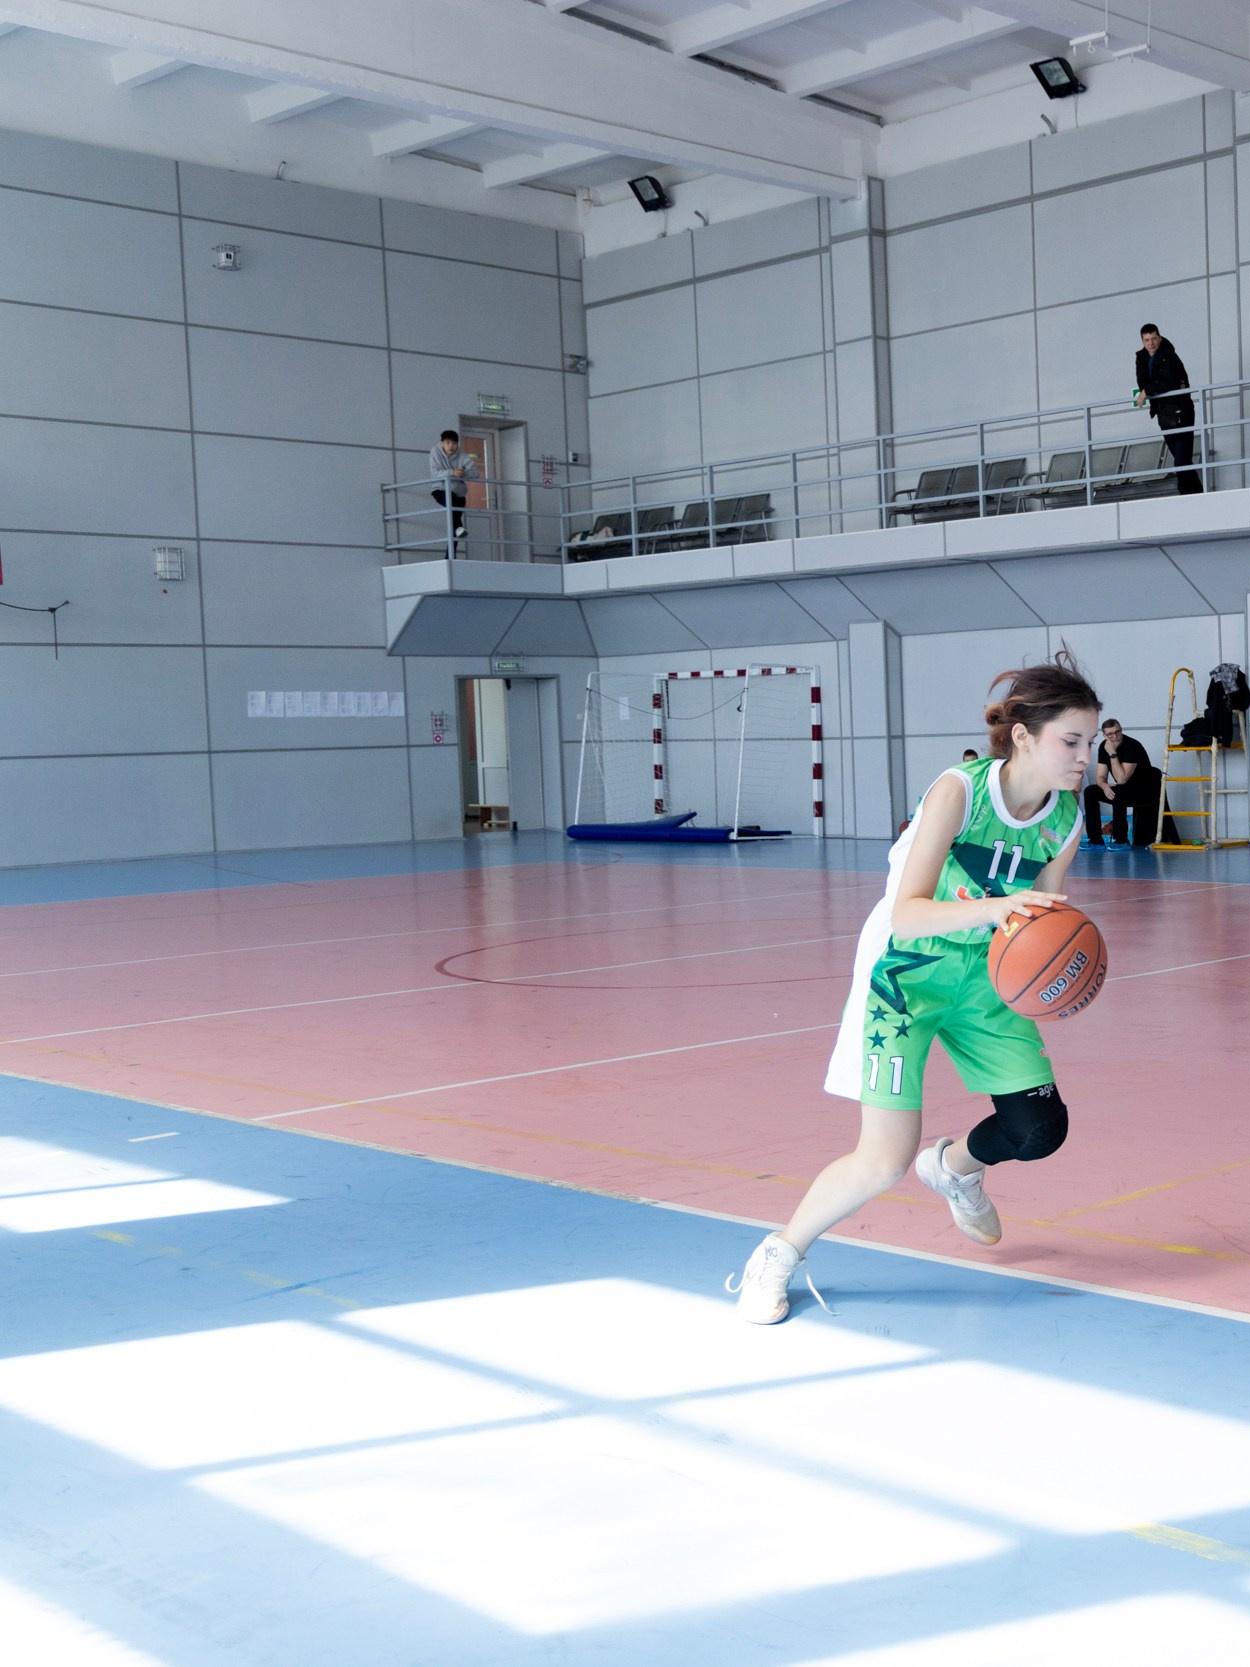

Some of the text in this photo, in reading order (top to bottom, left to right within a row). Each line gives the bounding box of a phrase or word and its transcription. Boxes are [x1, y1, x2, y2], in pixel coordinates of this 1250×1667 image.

[987, 839, 1024, 884] 11
[1039, 950, 1088, 1003] BM 600
[1058, 963, 1107, 1018] TORRES
[867, 1053, 905, 1095] 11
